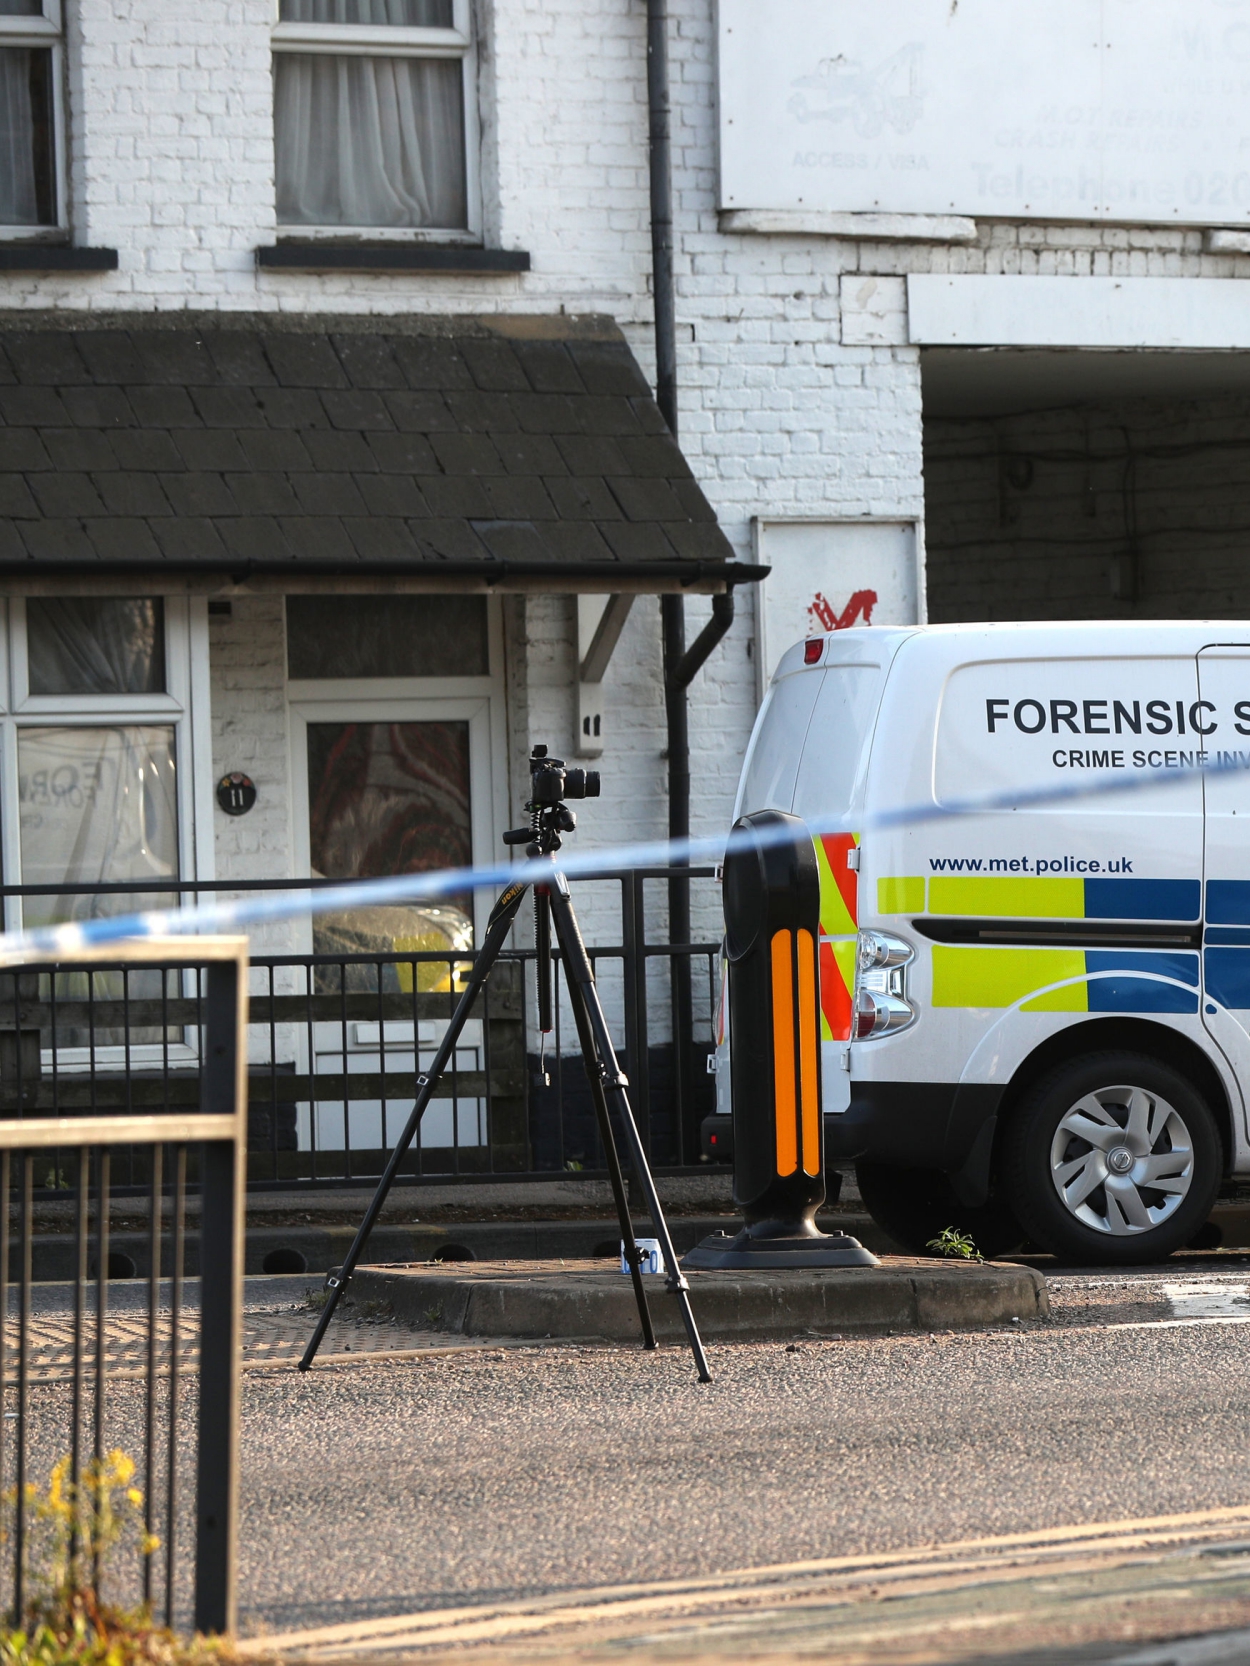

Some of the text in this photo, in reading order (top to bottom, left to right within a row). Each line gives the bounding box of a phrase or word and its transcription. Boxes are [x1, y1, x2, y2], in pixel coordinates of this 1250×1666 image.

[791, 150, 869, 170] ACCESS
[970, 160, 1178, 212] Telephone
[985, 698, 1219, 735] FORENSIC
[1051, 750, 1126, 768] CRIME
[1132, 750, 1210, 769] SCENE
[230, 788, 245, 808] 11
[929, 856, 1134, 876] www.met.police.uk
